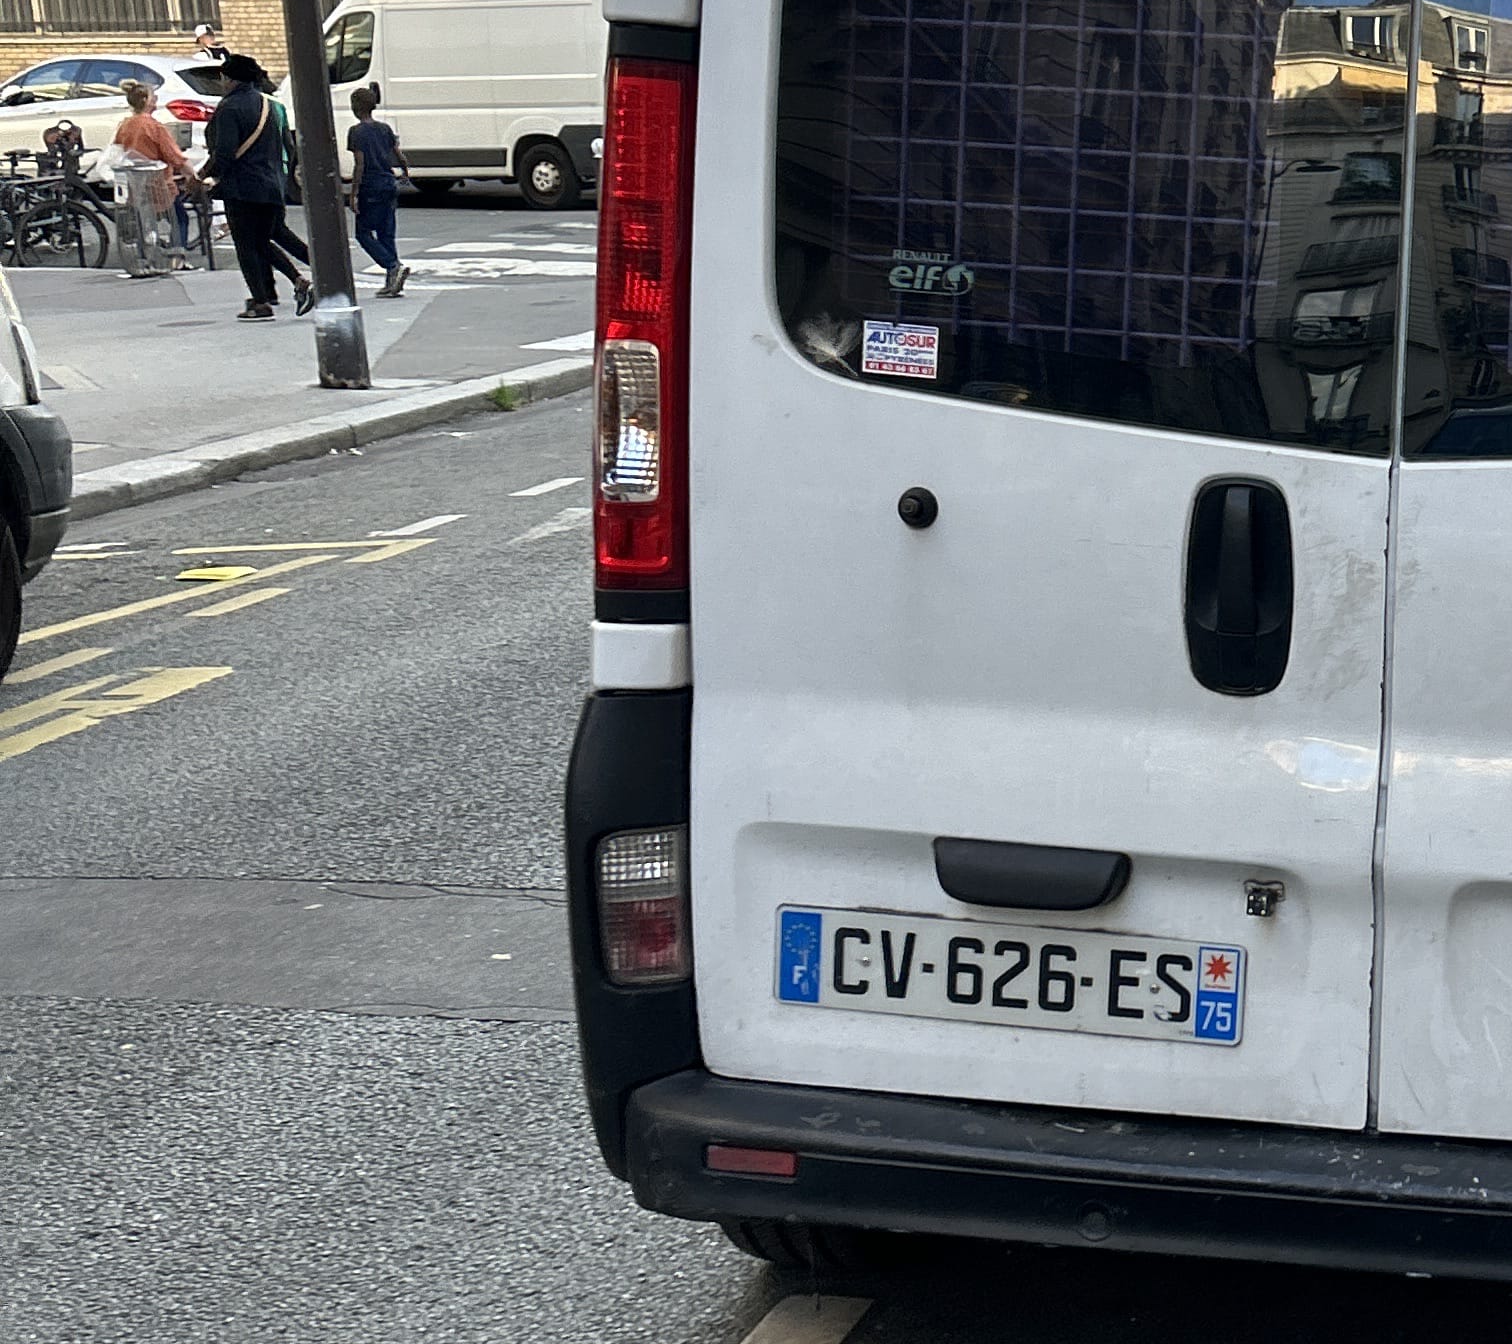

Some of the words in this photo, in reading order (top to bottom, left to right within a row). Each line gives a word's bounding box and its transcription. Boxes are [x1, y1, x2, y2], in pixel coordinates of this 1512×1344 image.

[893, 249, 951, 263] RENAULT
[889, 265, 943, 290] elf
[867, 331, 936, 349] AUTOSUR
[792, 965, 807, 985] F
[833, 927, 1192, 1023] CV-626-ES
[1201, 1002, 1233, 1033] 75
